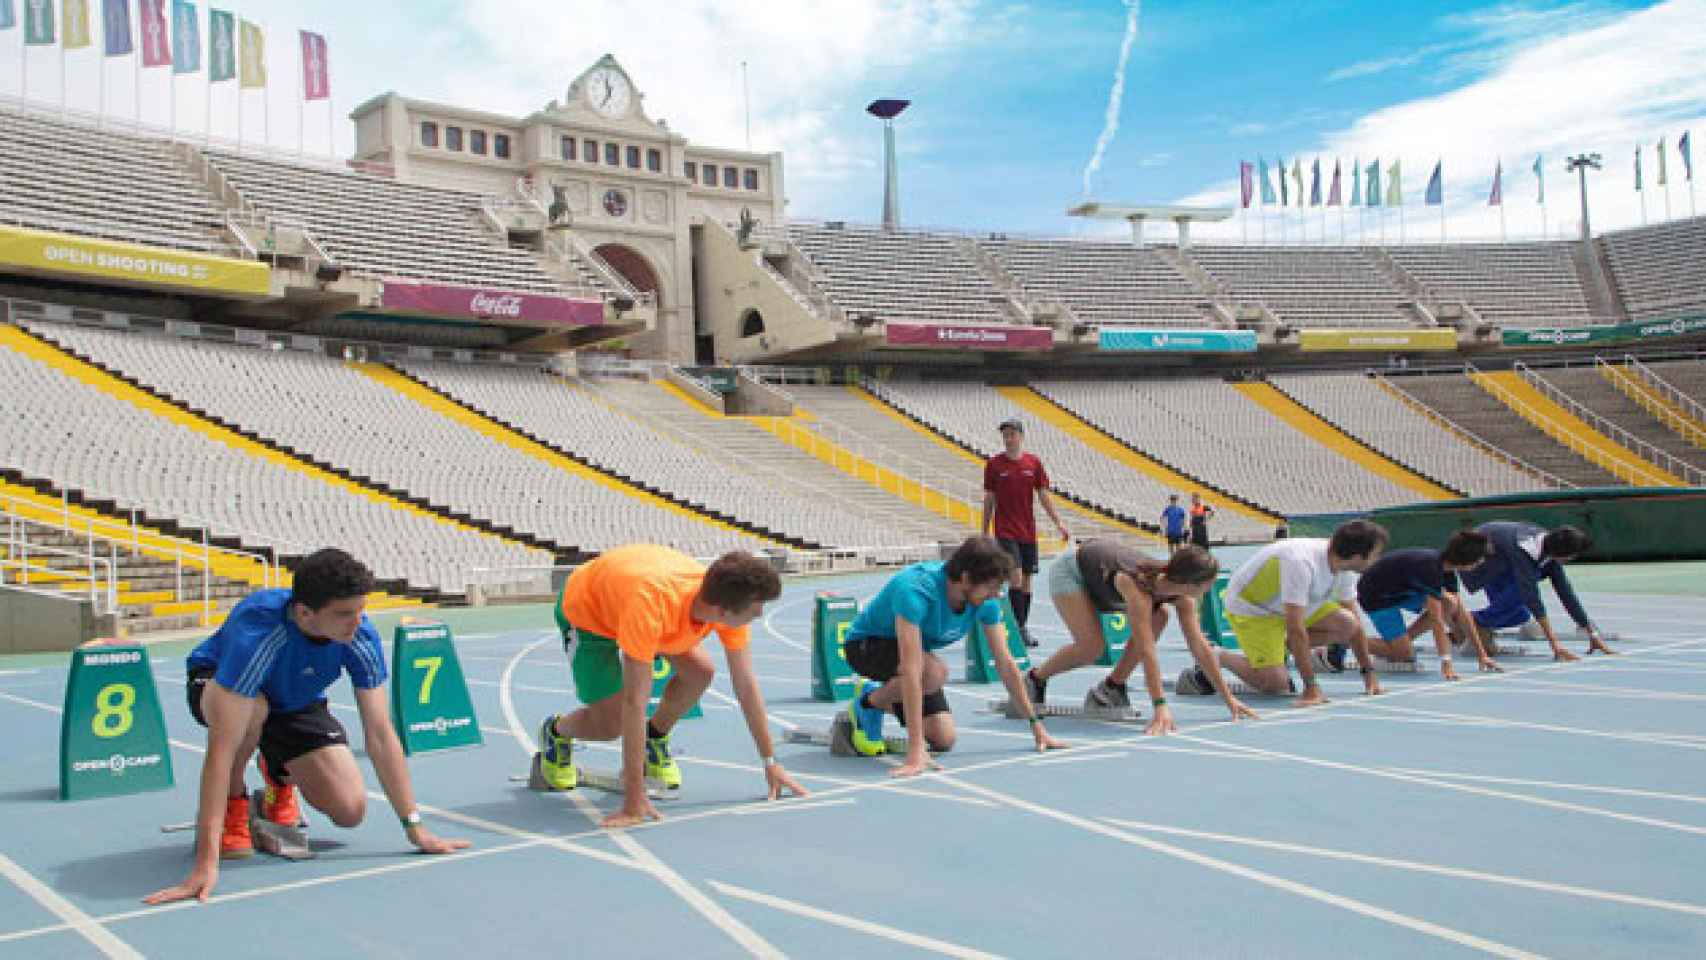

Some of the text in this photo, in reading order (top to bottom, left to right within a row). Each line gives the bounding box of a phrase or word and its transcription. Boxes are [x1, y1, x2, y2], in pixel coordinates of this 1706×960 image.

[43, 245, 92, 265] OPEN
[84, 652, 141, 666] MONDO
[413, 656, 444, 705] 7
[92, 683, 136, 738] 8
[73, 754, 161, 771] OPEN CAMP
